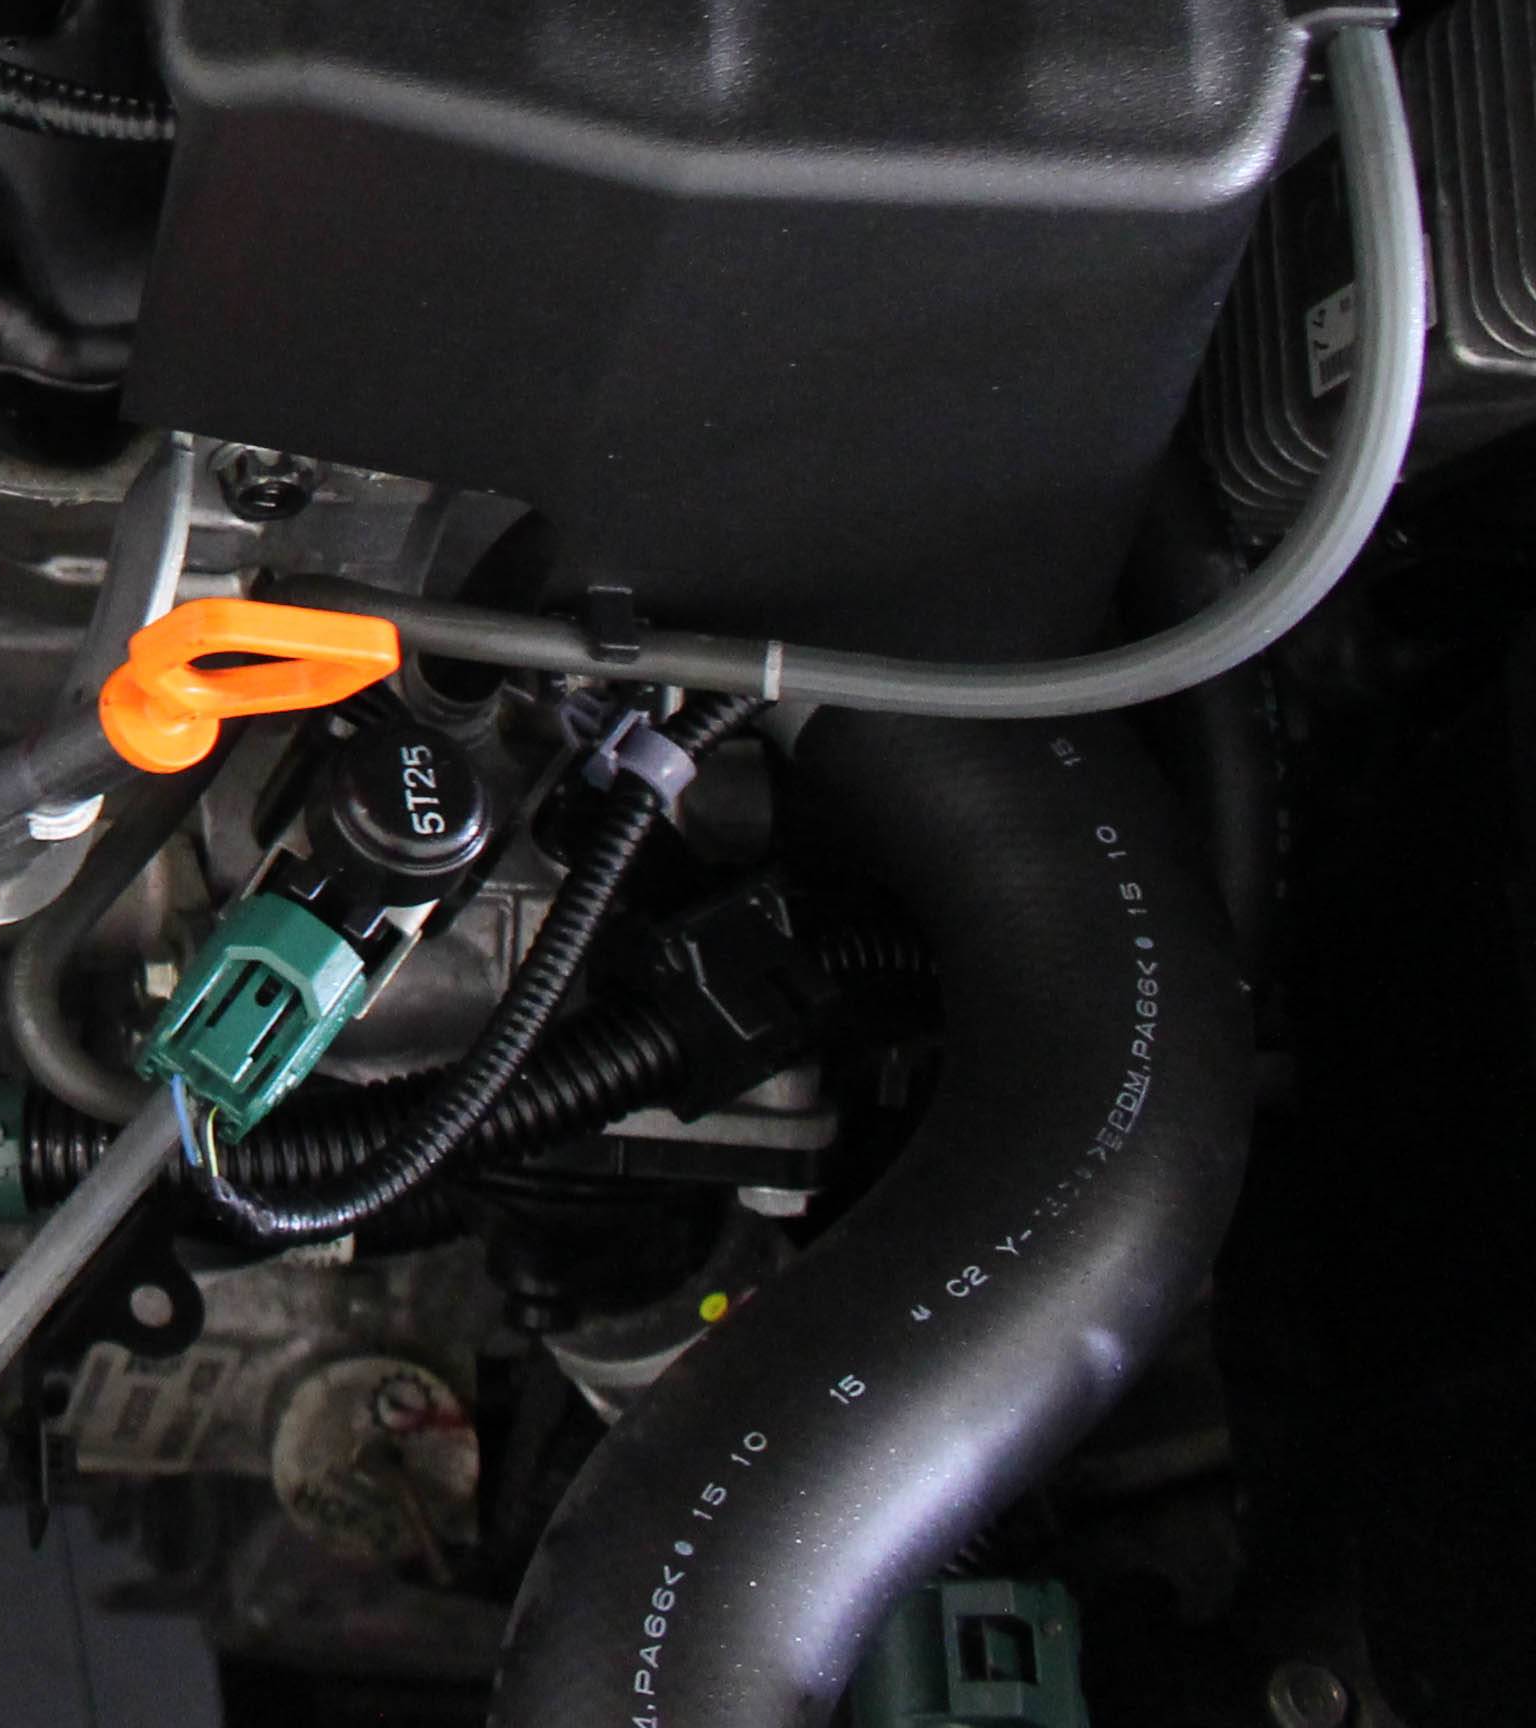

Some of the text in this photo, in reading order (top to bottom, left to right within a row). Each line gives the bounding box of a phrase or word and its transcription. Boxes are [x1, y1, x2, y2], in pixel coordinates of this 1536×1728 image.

[1048, 735, 1083, 768] 15
[400, 744, 446, 835] 5T25
[1094, 823, 1128, 861] 10
[1119, 881, 1148, 917] 15
[944, 1263, 993, 1299] C2
[828, 1372, 867, 1407] 15
[691, 1481, 728, 1522] 15
[729, 1429, 769, 1468] 10
